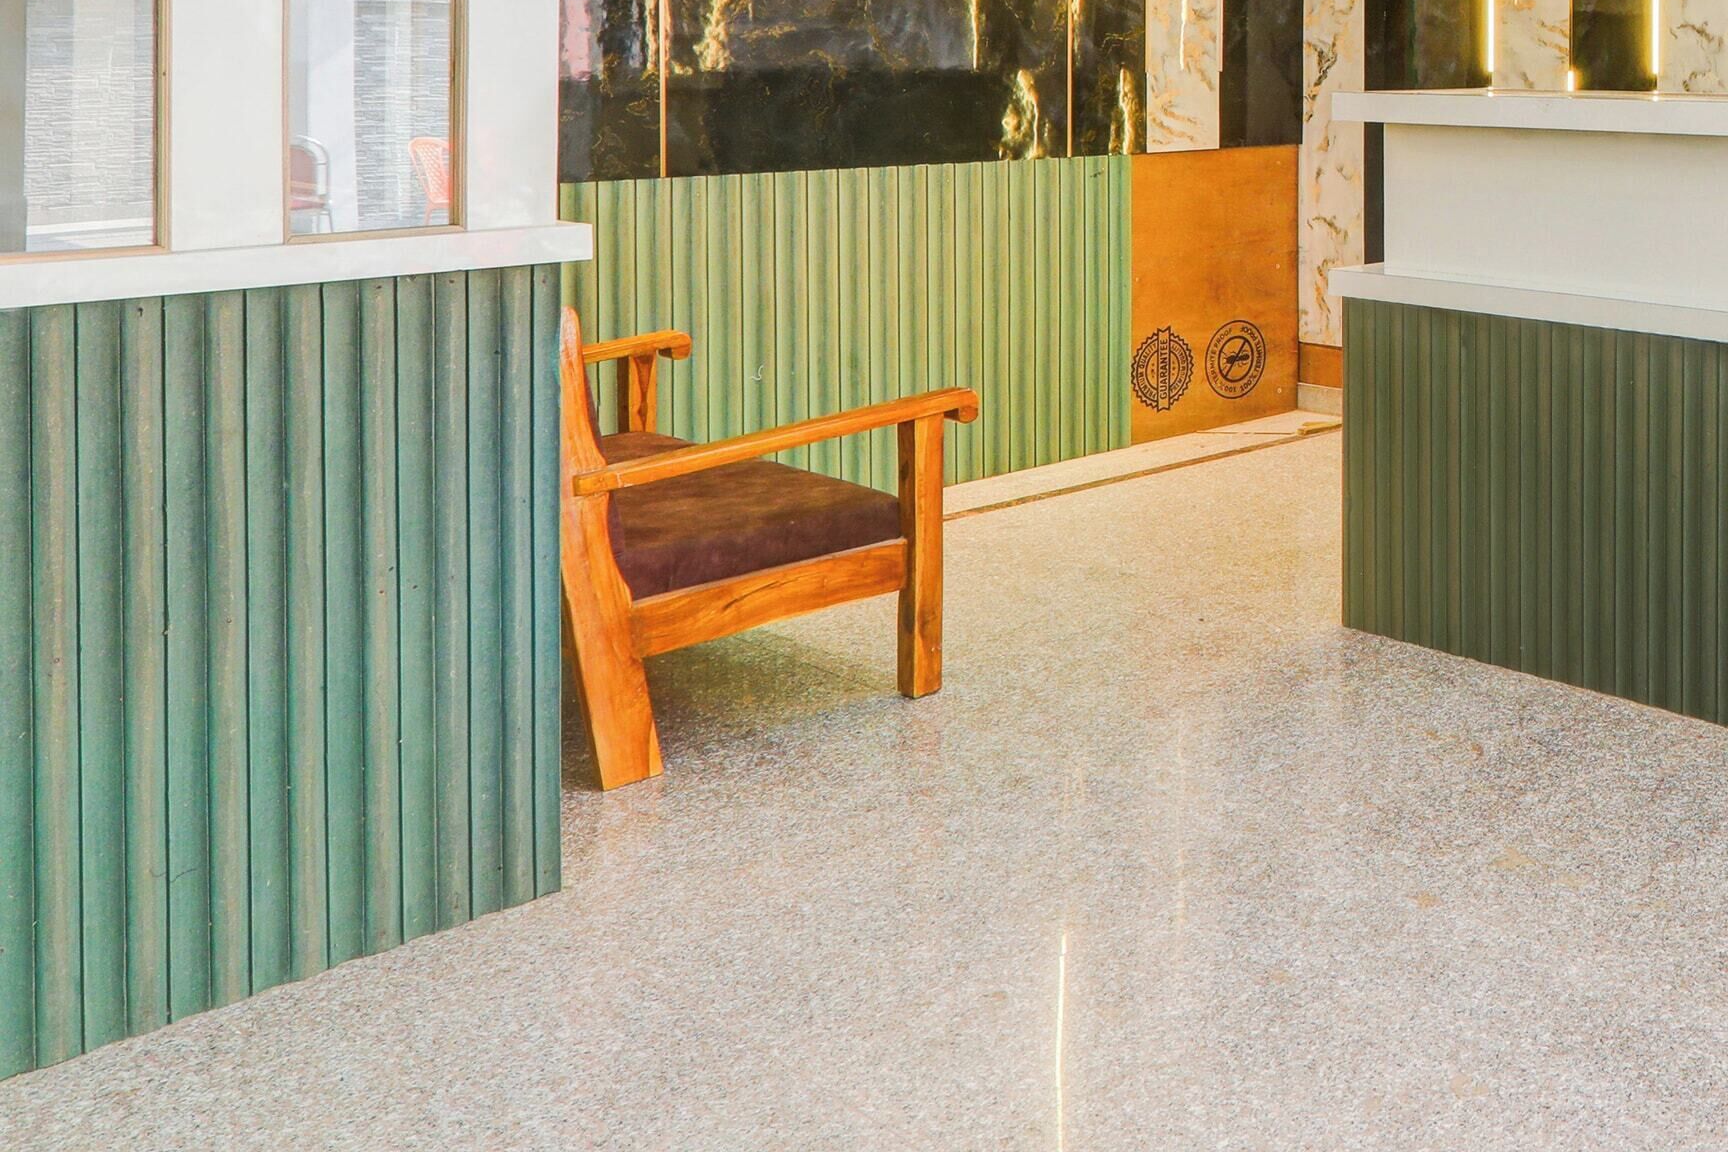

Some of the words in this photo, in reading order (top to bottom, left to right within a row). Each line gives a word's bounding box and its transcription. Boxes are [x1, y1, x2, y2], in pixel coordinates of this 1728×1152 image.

[1213, 327, 1233, 348] PROOF
[1140, 343, 1157, 369] QUALITY
[1160, 338, 1168, 399] GUARANTEE
[1210, 350, 1220, 385] TERMITE
[1253, 341, 1262, 373] TERMITE
[1137, 371, 1157, 399] PREMIUM
